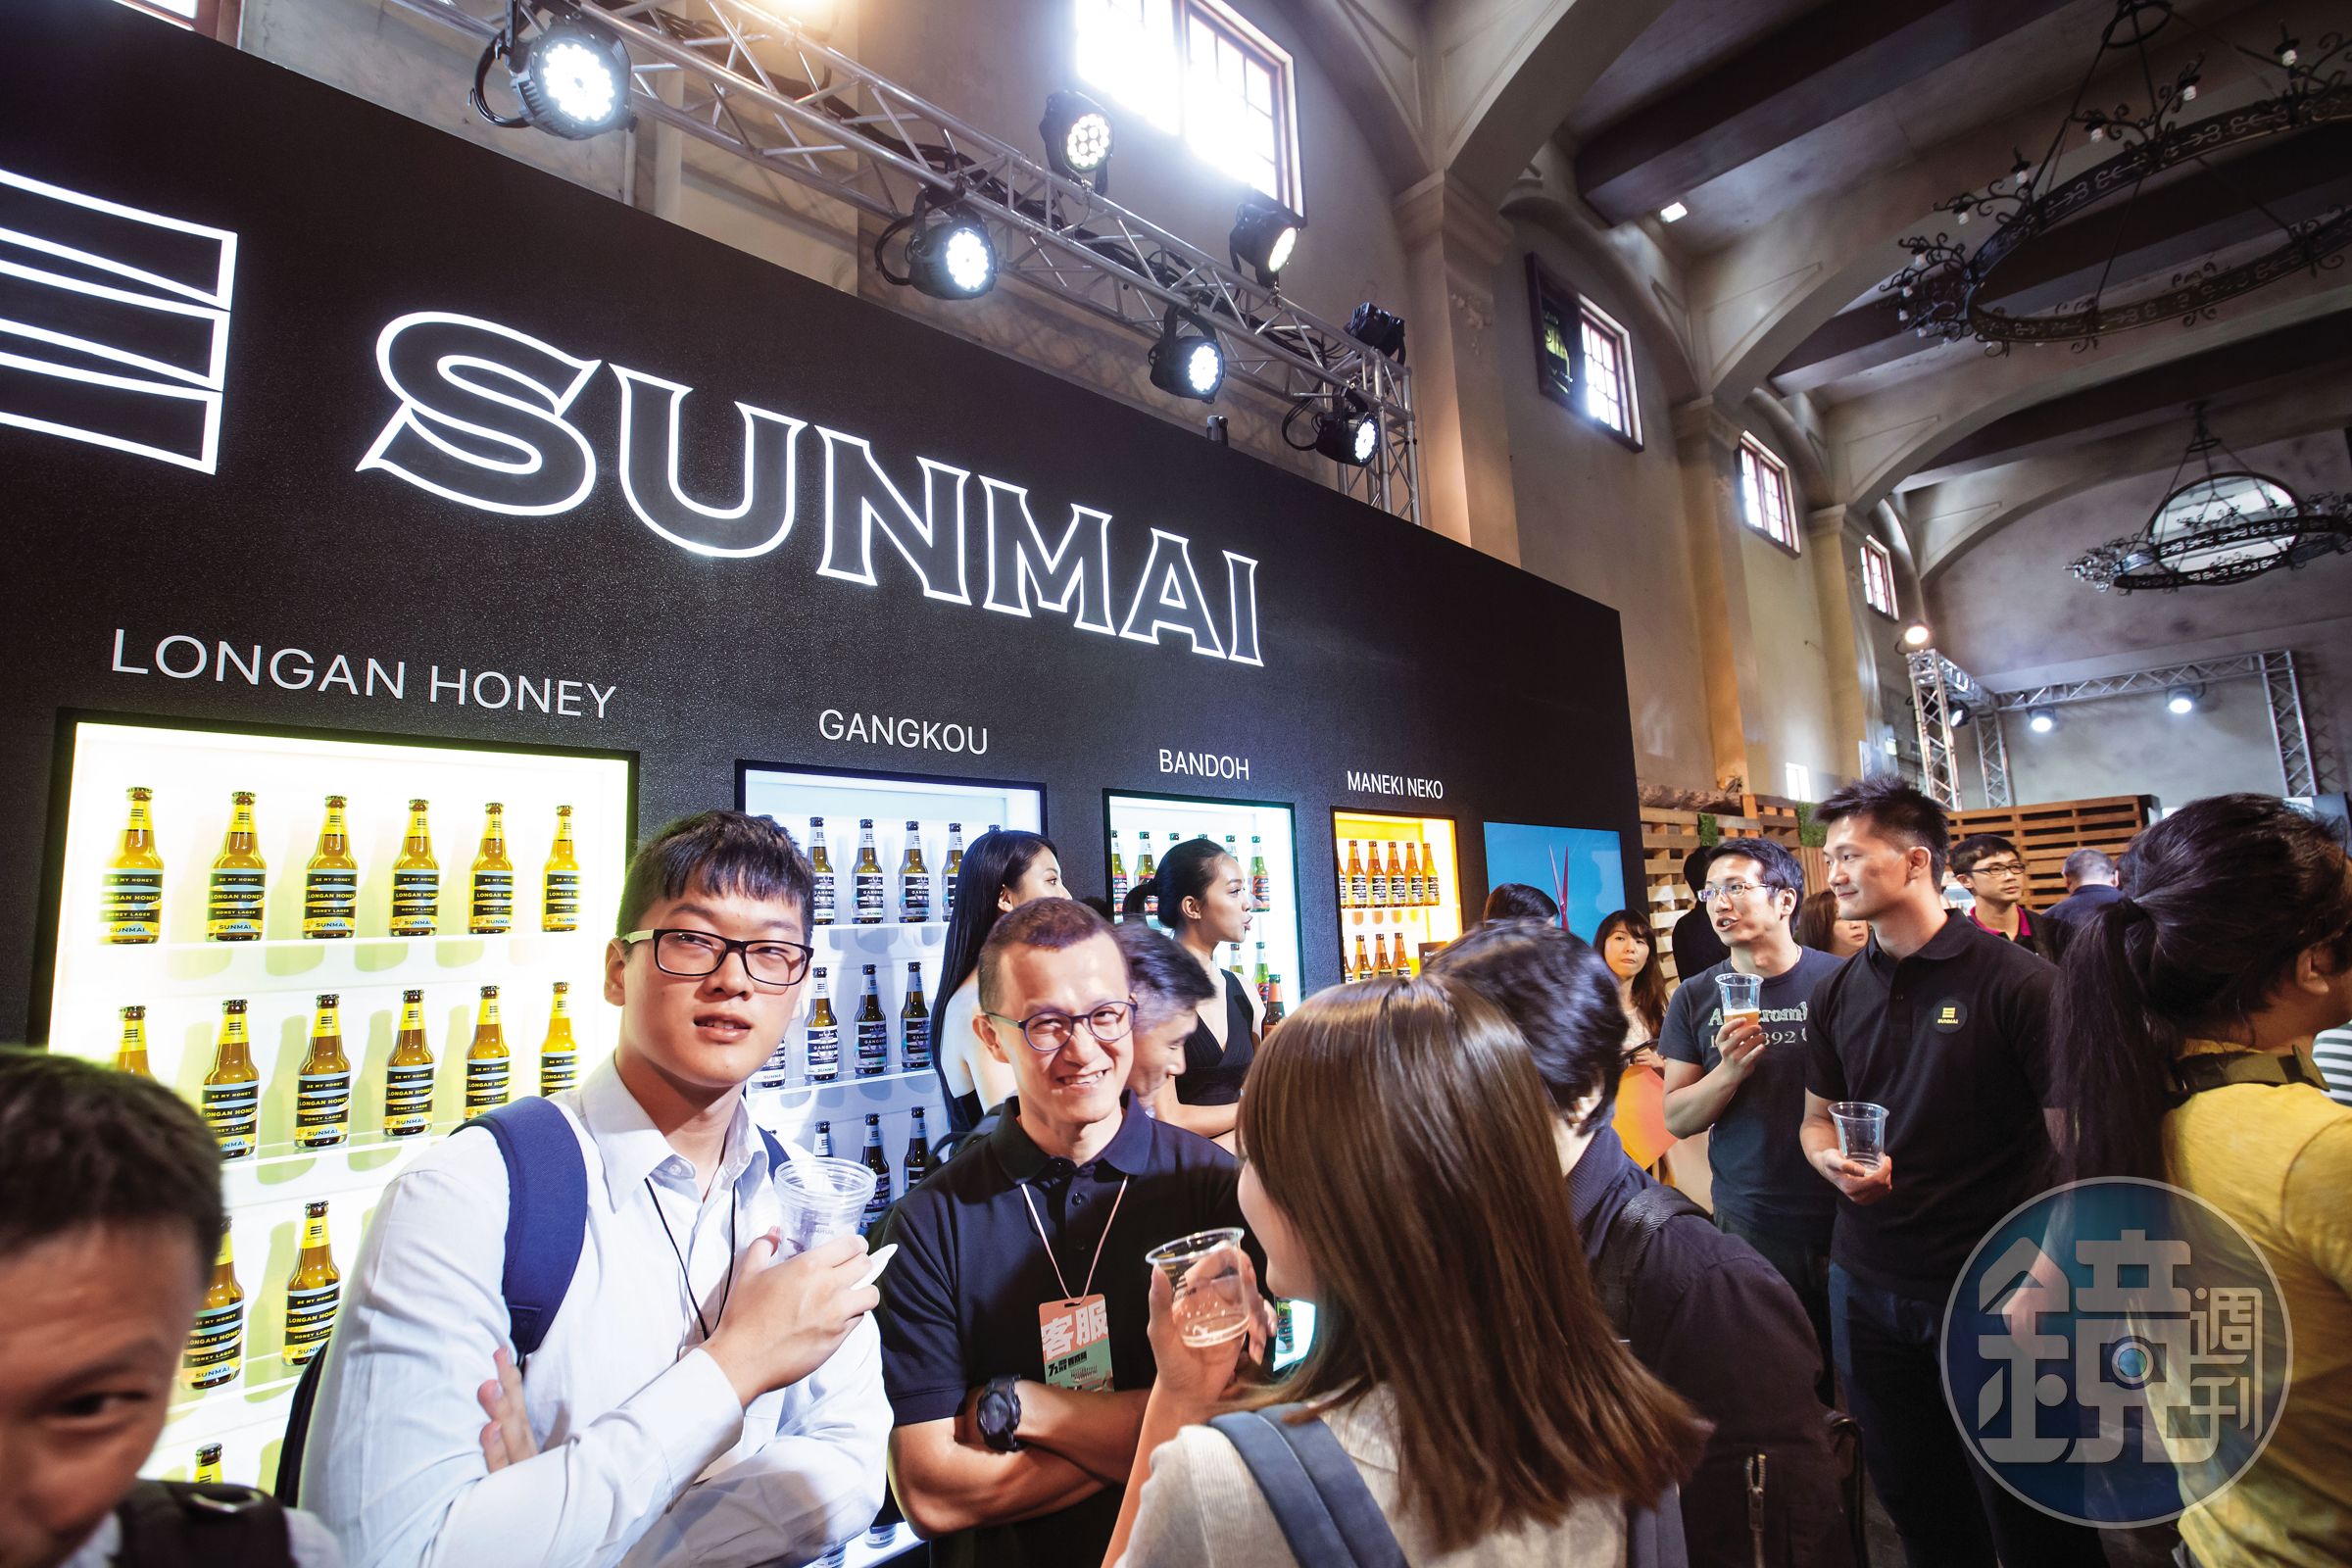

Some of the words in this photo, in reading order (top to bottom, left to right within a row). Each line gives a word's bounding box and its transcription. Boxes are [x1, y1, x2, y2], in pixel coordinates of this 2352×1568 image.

[356, 312, 1264, 666] SUNMAI
[112, 628, 405, 700] LONGAN
[429, 665, 617, 719] HONEY
[818, 709, 988, 756] GANGKOU
[1158, 748, 1250, 780] BANDOH
[1347, 770, 1404, 796] MANEKI
[1407, 777, 1444, 799] NEKO
[216, 1313, 236, 1322] HONEY
[1041, 1299, 1108, 1360] 客服
[220, 1329, 240, 1341] HONEY
[195, 1366, 230, 1378] SUNMAI
